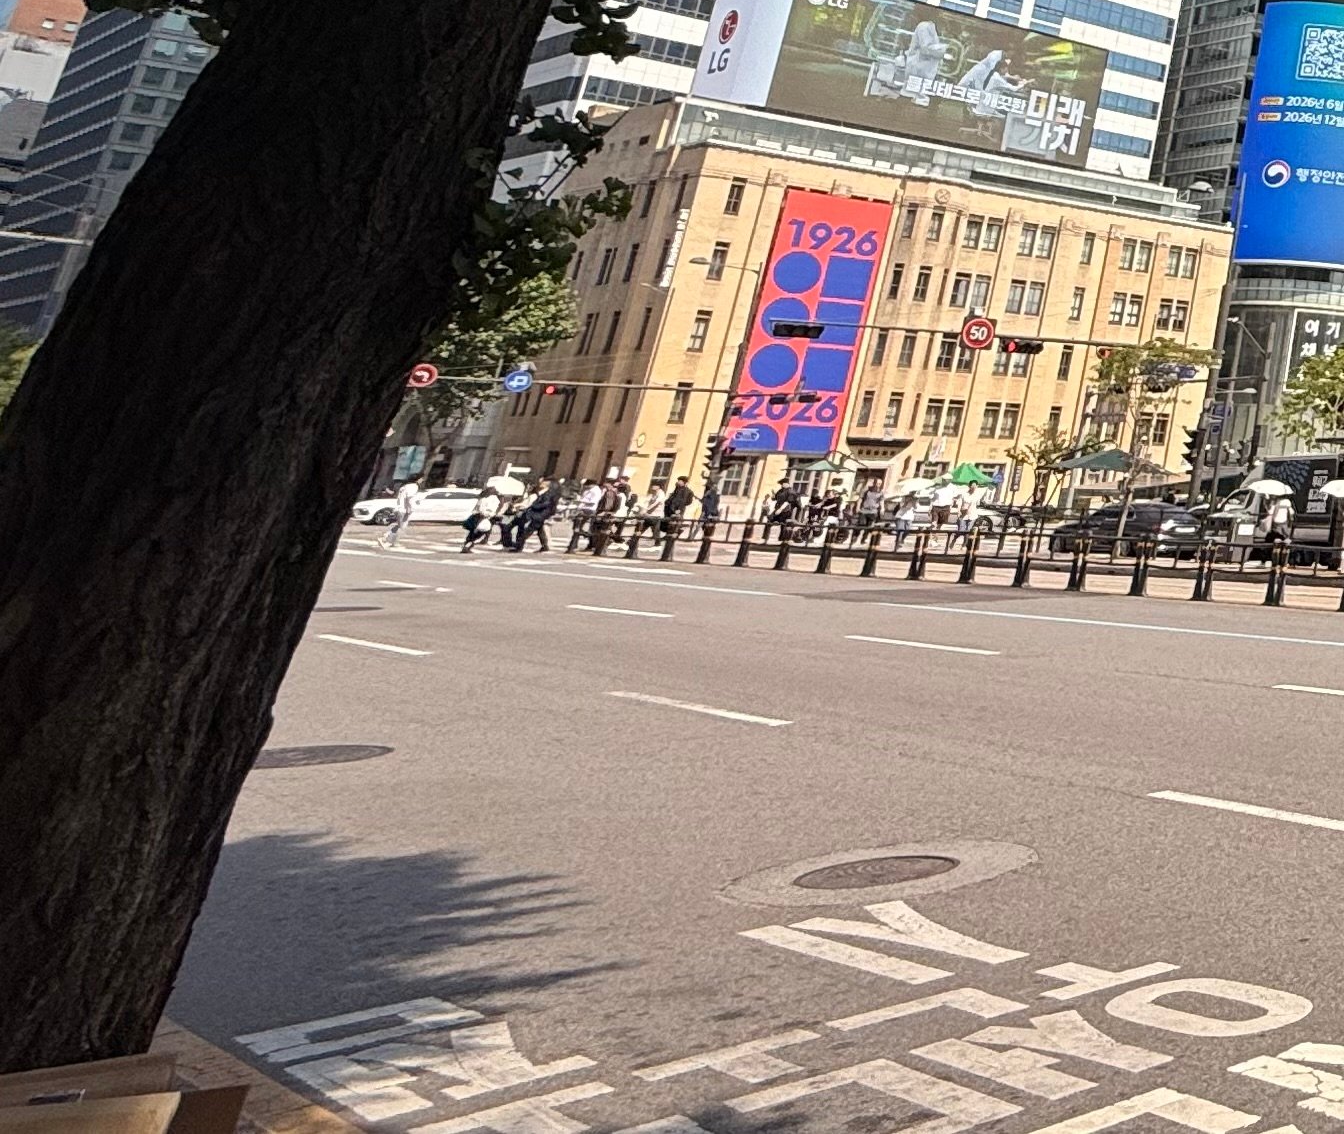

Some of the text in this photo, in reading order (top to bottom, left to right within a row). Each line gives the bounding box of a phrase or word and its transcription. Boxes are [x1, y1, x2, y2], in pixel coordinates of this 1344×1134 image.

[707, 47, 731, 74] LG
[1025, 89, 1087, 128] 미래
[1286, 96, 1324, 109] 2026년
[1283, 111, 1322, 125] 2026년
[1324, 114, 1344, 128] 12월
[788, 219, 877, 256] 1926
[969, 325, 988, 341] 50
